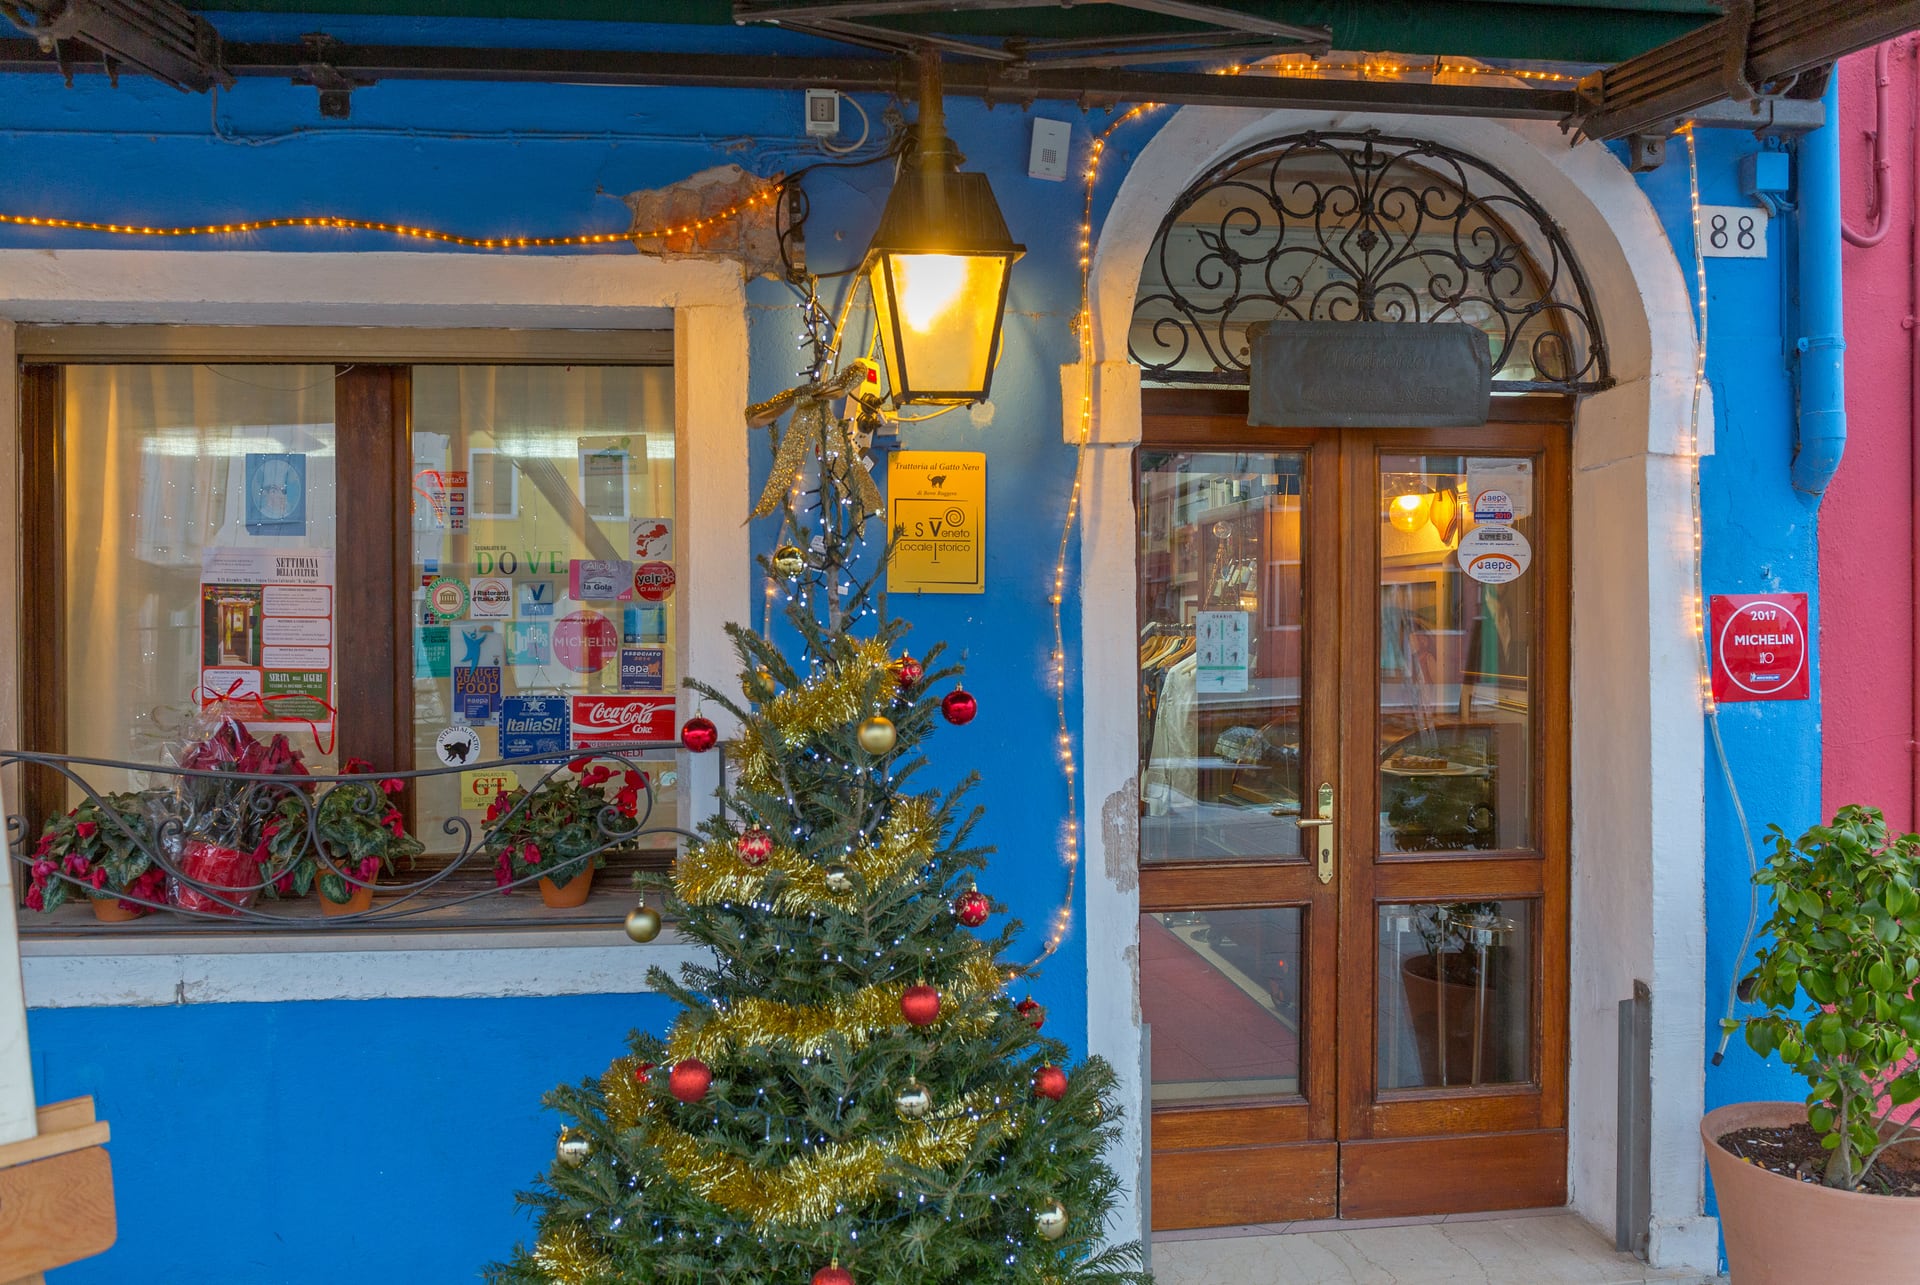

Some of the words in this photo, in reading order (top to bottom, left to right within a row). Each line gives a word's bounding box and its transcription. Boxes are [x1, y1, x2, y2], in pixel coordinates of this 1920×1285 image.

[1710, 214, 1755, 250] 88
[895, 462, 928, 470] Trattoria
[930, 462, 938, 470] al
[939, 462, 960, 471] Gatto
[962, 463, 980, 472] Nero
[900, 542, 932, 552] Locale
[938, 542, 970, 552] storico
[276, 557, 319, 568] SETTIMANA
[276, 568, 294, 576] DELLA
[294, 568, 319, 577] CULTURA
[638, 574, 662, 585] yelp
[1750, 610, 1776, 620] 2017
[572, 616, 598, 625] 2017
[554, 637, 616, 647] MICHELIN
[1734, 634, 1794, 646] MICHELIN
[456, 668, 498, 676] VENICE
[622, 665, 649, 674] aepa
[269, 674, 290, 682] SERATA
[303, 674, 322, 682] AUGURI
[457, 683, 499, 694] FOOD
[590, 702, 655, 724] Coca-Cola
[506, 718, 562, 732] ItaliaSi!
[632, 724, 653, 734] Coke
[438, 726, 460, 743] ATTENTI
[468, 731, 479, 751] GATTO
[472, 778, 507, 796] GT
